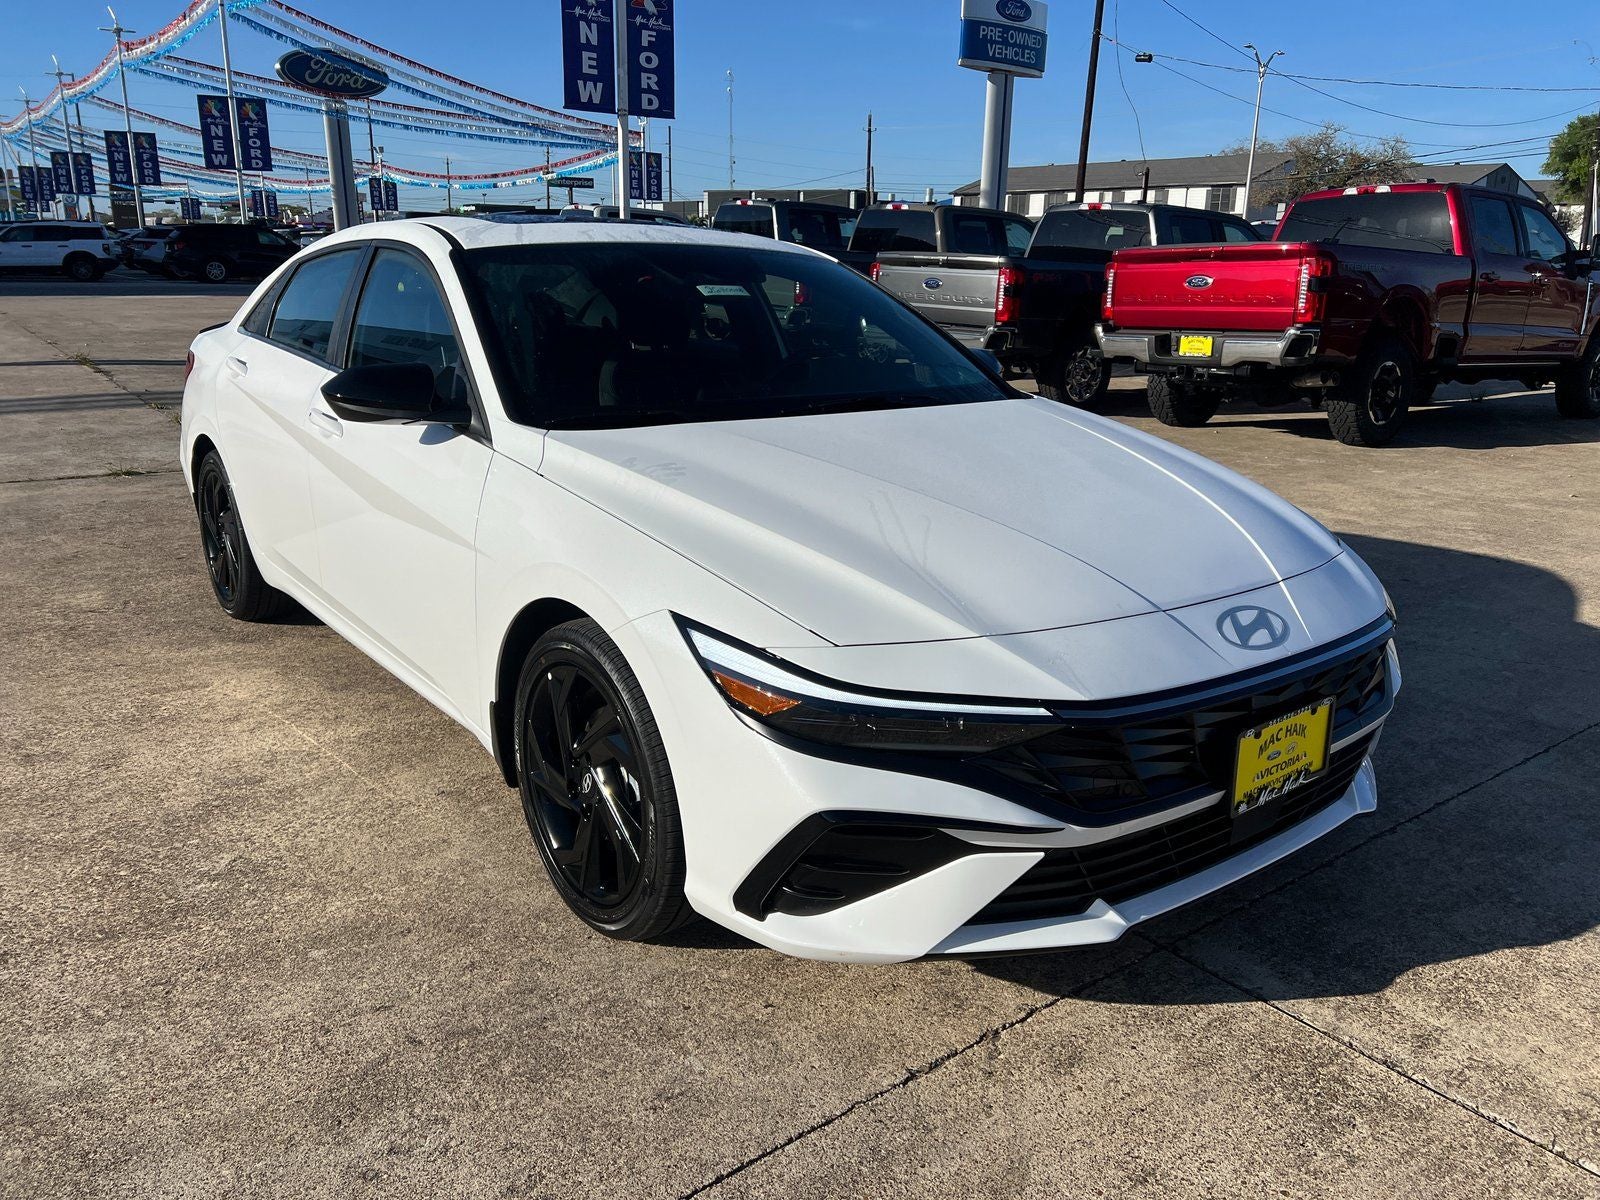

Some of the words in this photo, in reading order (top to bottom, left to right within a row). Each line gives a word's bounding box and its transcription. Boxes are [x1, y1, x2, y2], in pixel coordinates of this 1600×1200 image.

[1006, 1, 1026, 17] Ford
[980, 25, 1042, 48] PRE-OWNED
[577, 20, 603, 104] NEW
[987, 44, 1036, 64] VEHICLES
[305, 58, 367, 89] Ford
[639, 29, 659, 110] FORD
[210, 124, 228, 166] NEW
[248, 127, 263, 168] FORD
[58, 168, 69, 191] NEW
[81, 169, 91, 193] FORD
[113, 152, 127, 182] NEW
[143, 153, 154, 183] FORD
[631, 170, 640, 197] NEW
[650, 172, 658, 199] FORD
[1258, 728, 1283, 758] MAC
[1284, 723, 1308, 739] HAIK
[1257, 787, 1281, 806] Mac
